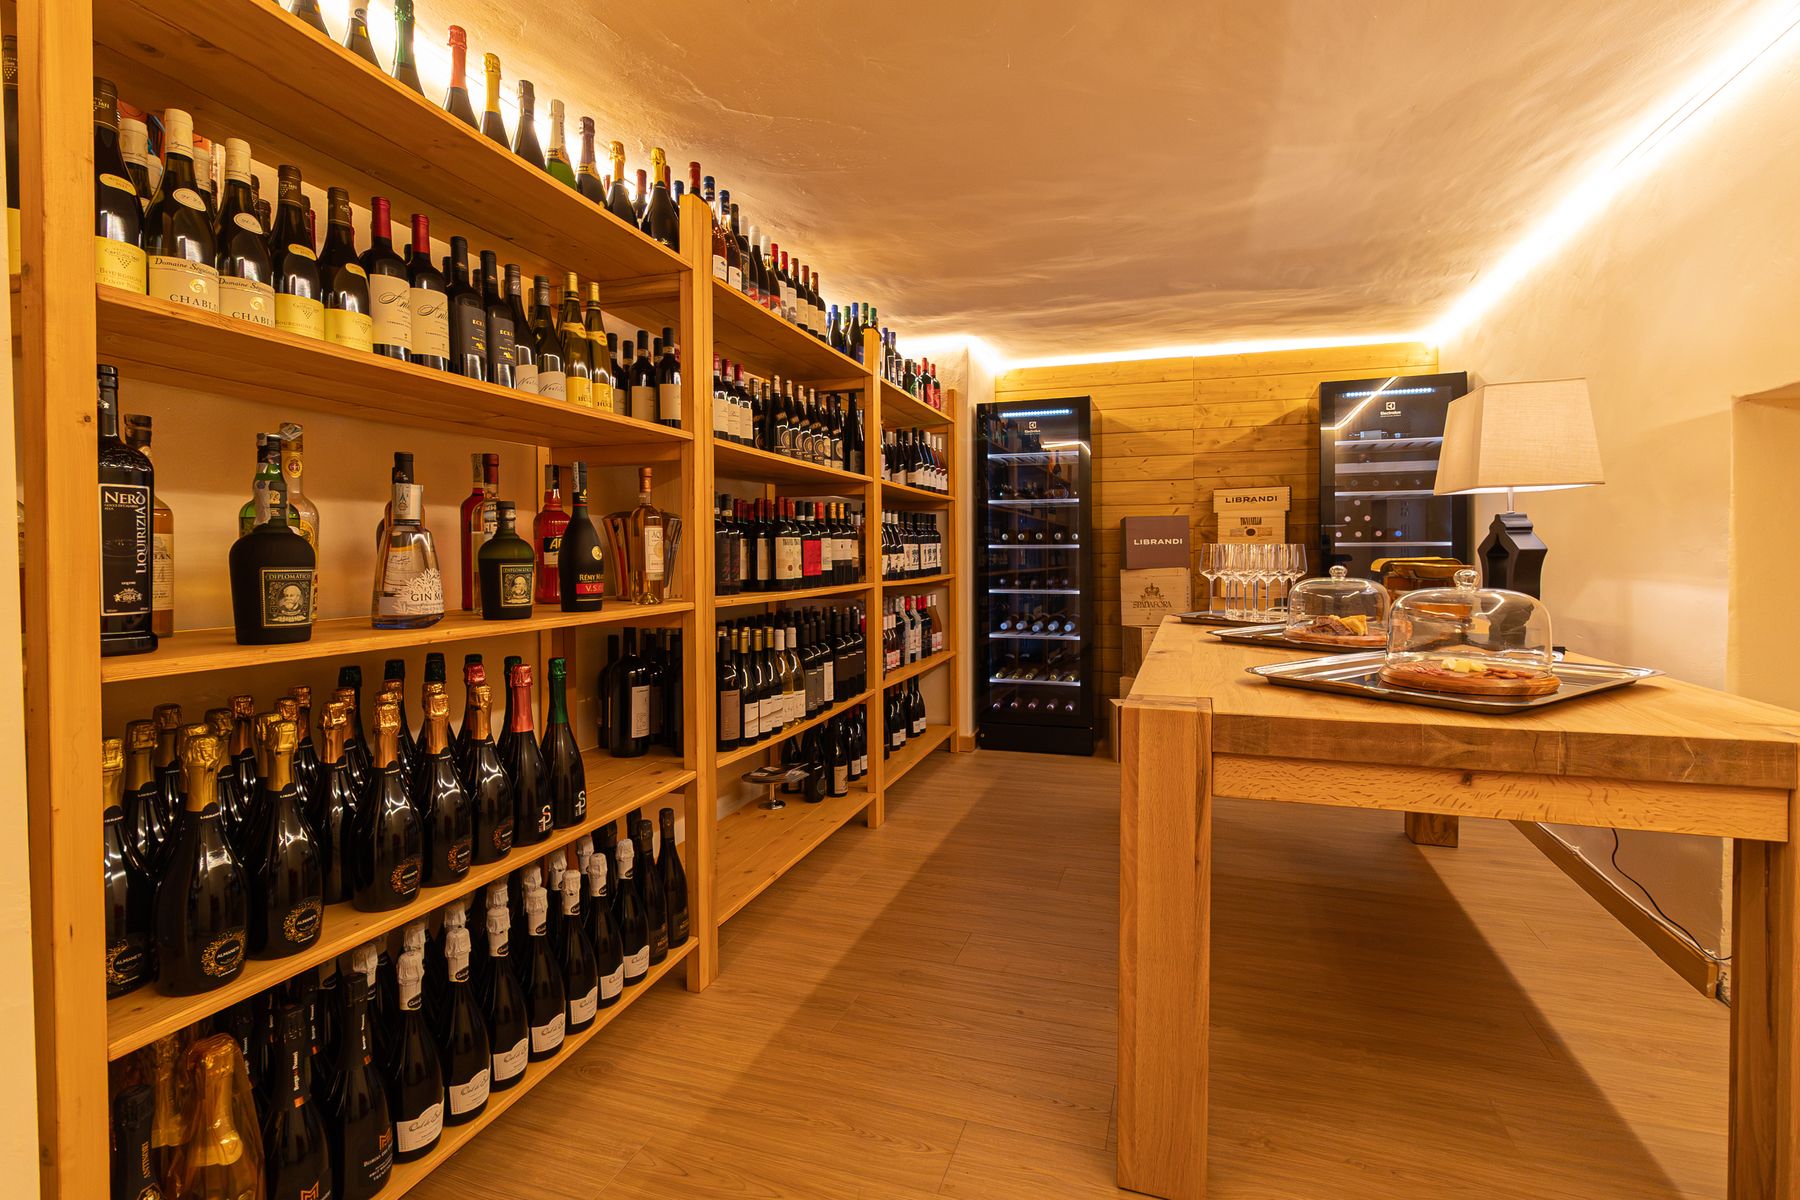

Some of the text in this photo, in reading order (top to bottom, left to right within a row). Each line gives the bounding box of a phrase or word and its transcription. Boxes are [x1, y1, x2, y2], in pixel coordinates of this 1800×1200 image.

[155, 258, 188, 268] Domaine
[1225, 495, 1278, 503] LIBRANDI
[135, 505, 148, 574] LIQUIRIZIA
[1133, 538, 1183, 546] LIBRANDI
[410, 593, 432, 602] GIN
